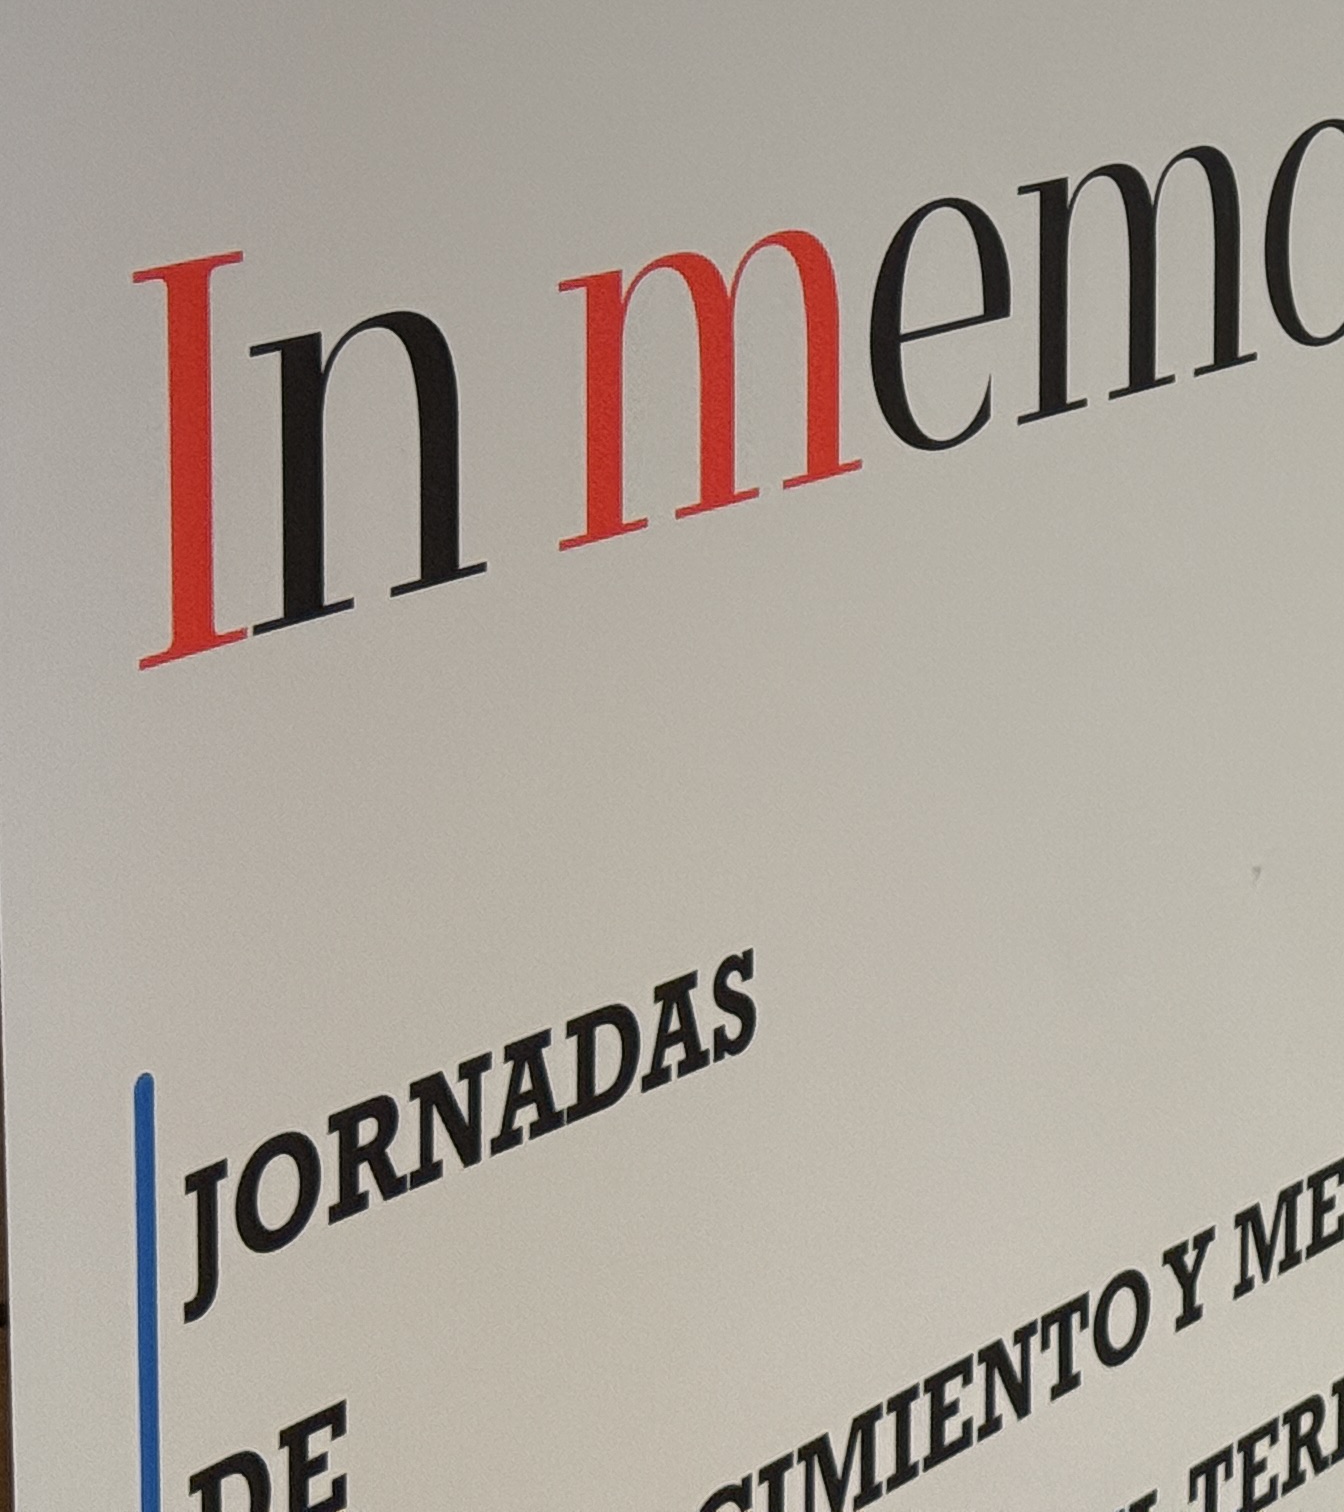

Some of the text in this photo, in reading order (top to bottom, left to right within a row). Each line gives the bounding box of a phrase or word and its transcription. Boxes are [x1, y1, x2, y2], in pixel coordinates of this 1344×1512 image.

[131, 250, 488, 671] In
[182, 946, 758, 1325] JORNADAS
[1161, 1225, 1216, 1333] Y
